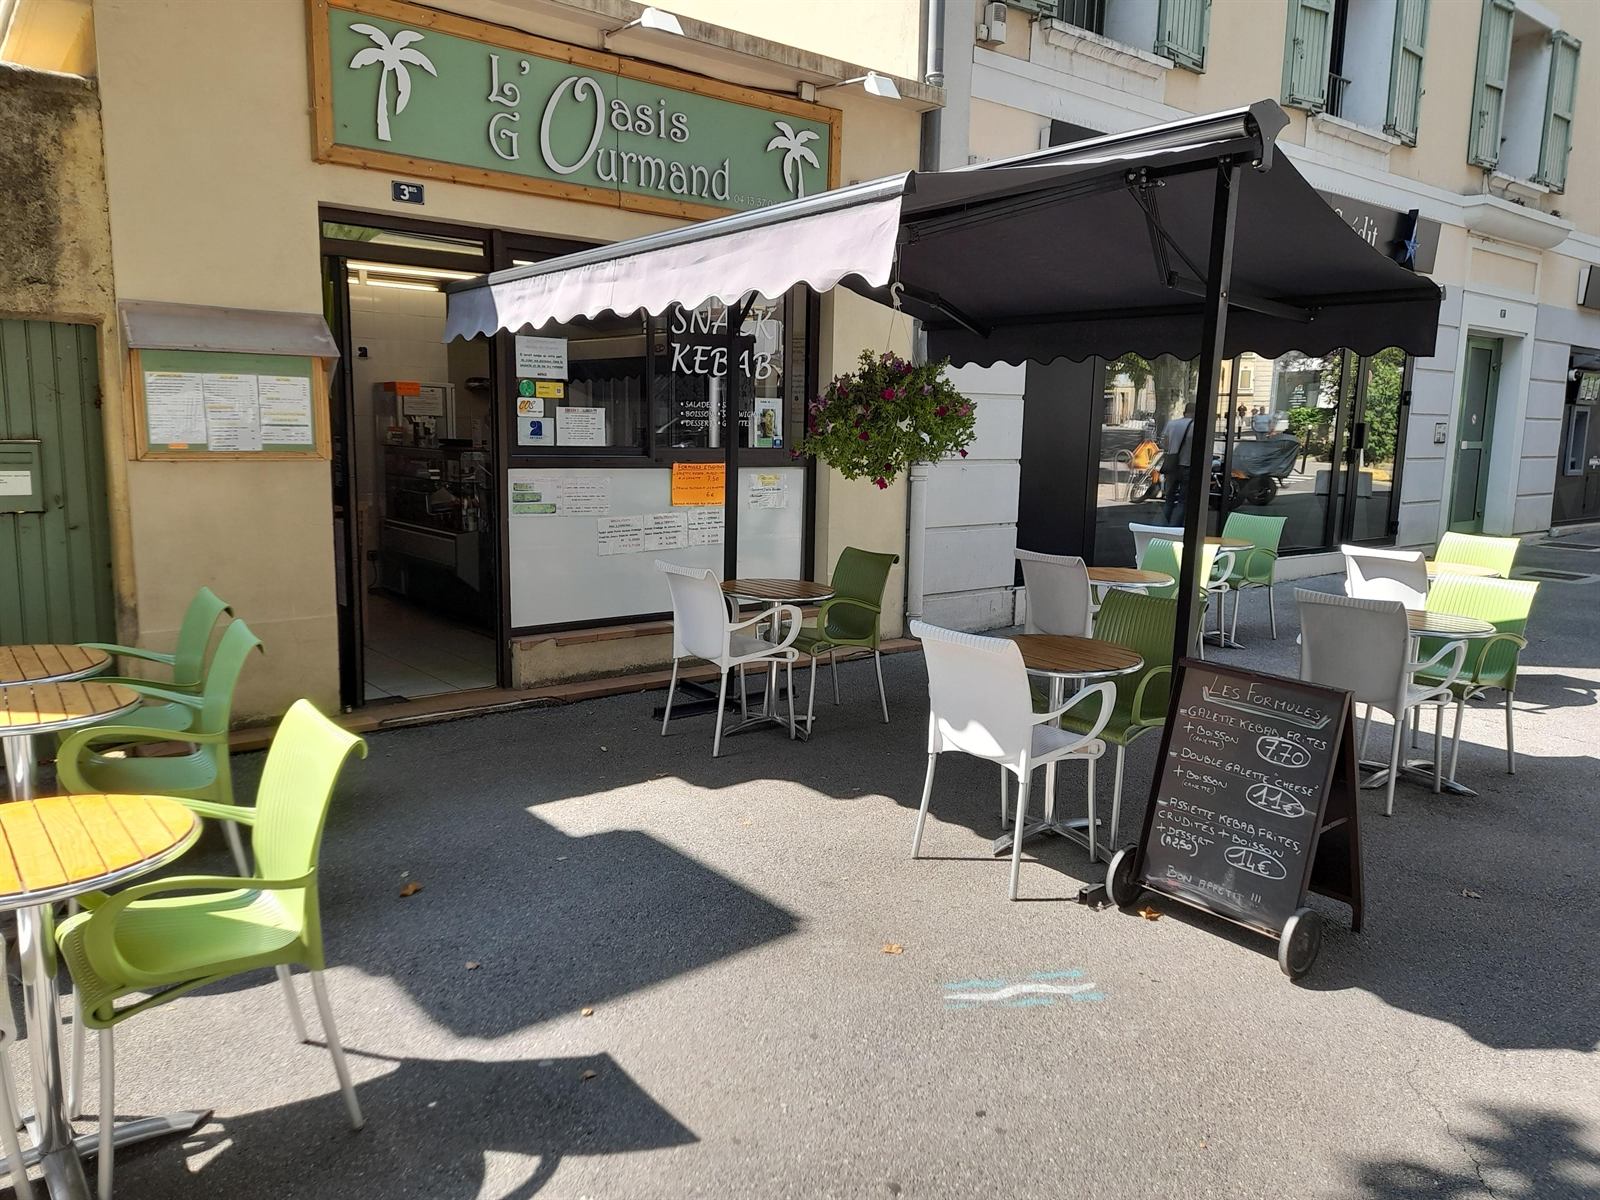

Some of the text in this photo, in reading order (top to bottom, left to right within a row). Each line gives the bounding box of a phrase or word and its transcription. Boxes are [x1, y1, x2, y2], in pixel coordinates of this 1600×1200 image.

[1208, 675, 1321, 720] LES FORMULES
[1187, 705, 1235, 727] GALETTE
[1287, 730, 1328, 750] FRITES
[1180, 747, 1223, 768] DOUBLE
[1225, 762, 1270, 784] GALETTE
[1169, 797, 1216, 821] ASSIETTE
[1167, 826, 1215, 846] DESSERT
[1166, 864, 1193, 883] BON
